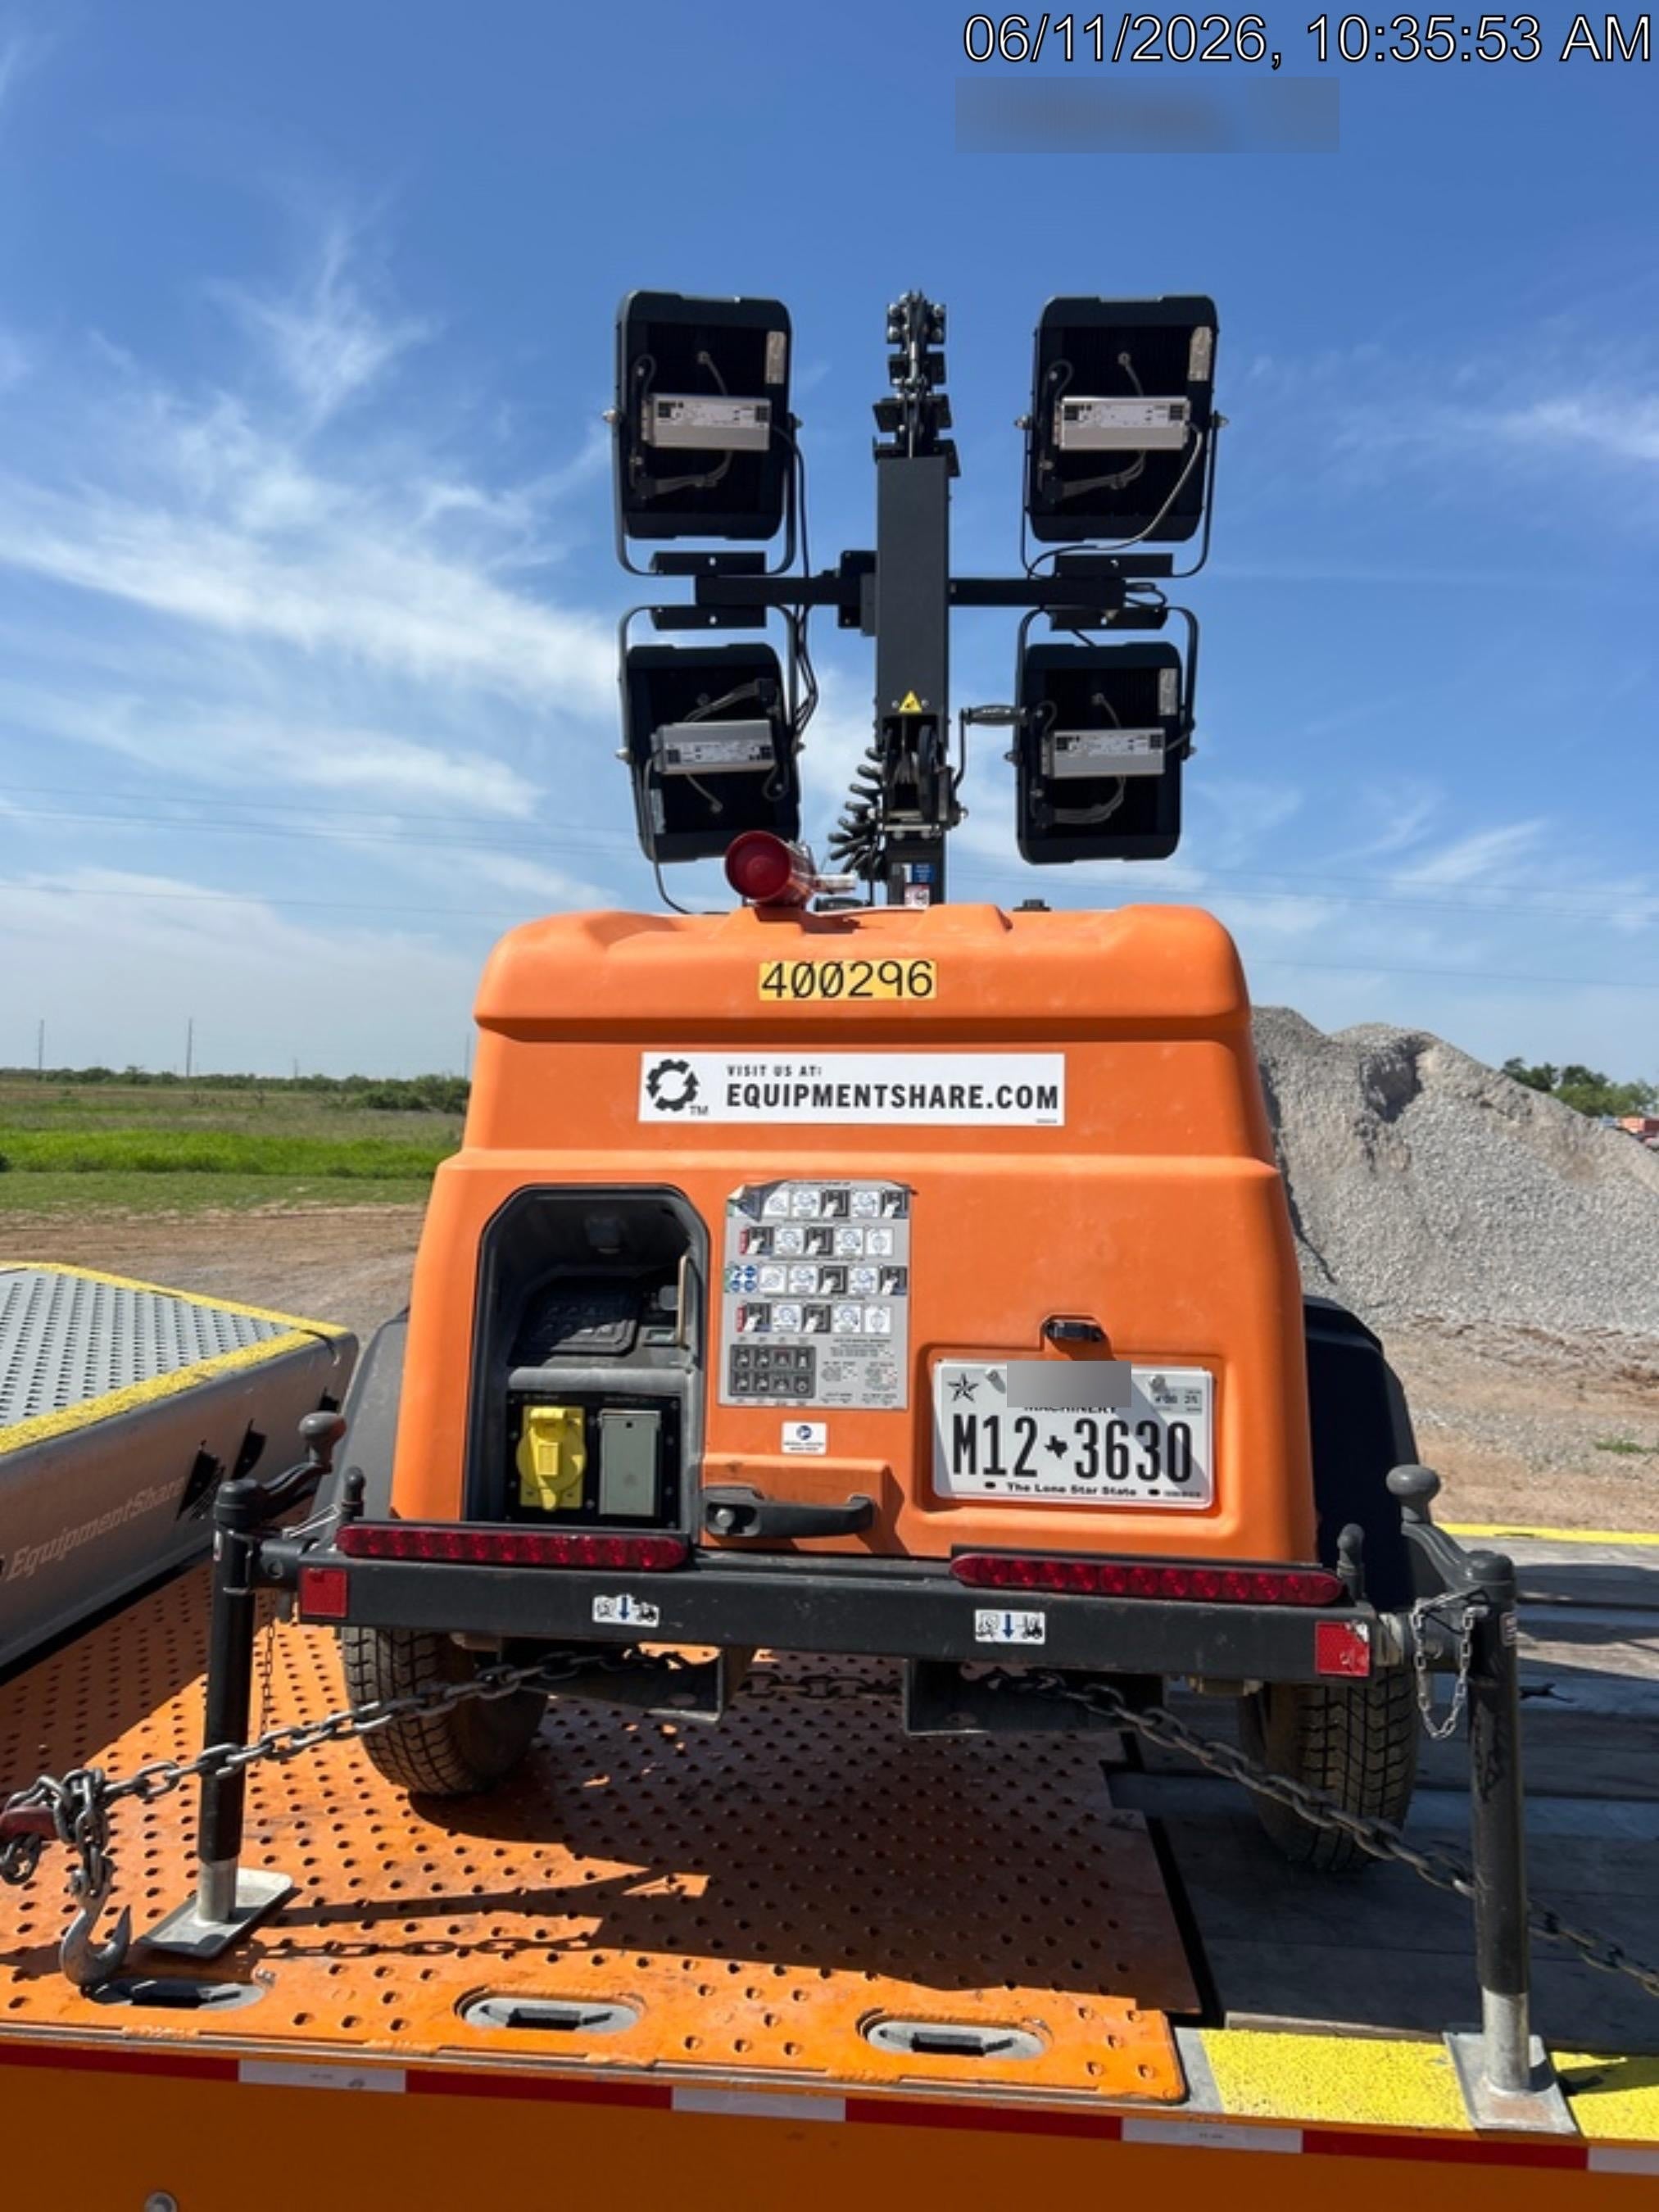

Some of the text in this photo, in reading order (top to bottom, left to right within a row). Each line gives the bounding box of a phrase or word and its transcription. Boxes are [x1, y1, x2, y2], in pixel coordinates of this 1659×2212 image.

[761, 961, 932, 999] 400296
[727, 1065, 768, 1077] VISIT
[773, 1065, 793, 1077] US
[727, 1083, 1058, 1109] EQUIPMENTSHARE.COM
[953, 1413, 1193, 1484] M12 3630
[1007, 1481, 1138, 1497] The Lone Star State
